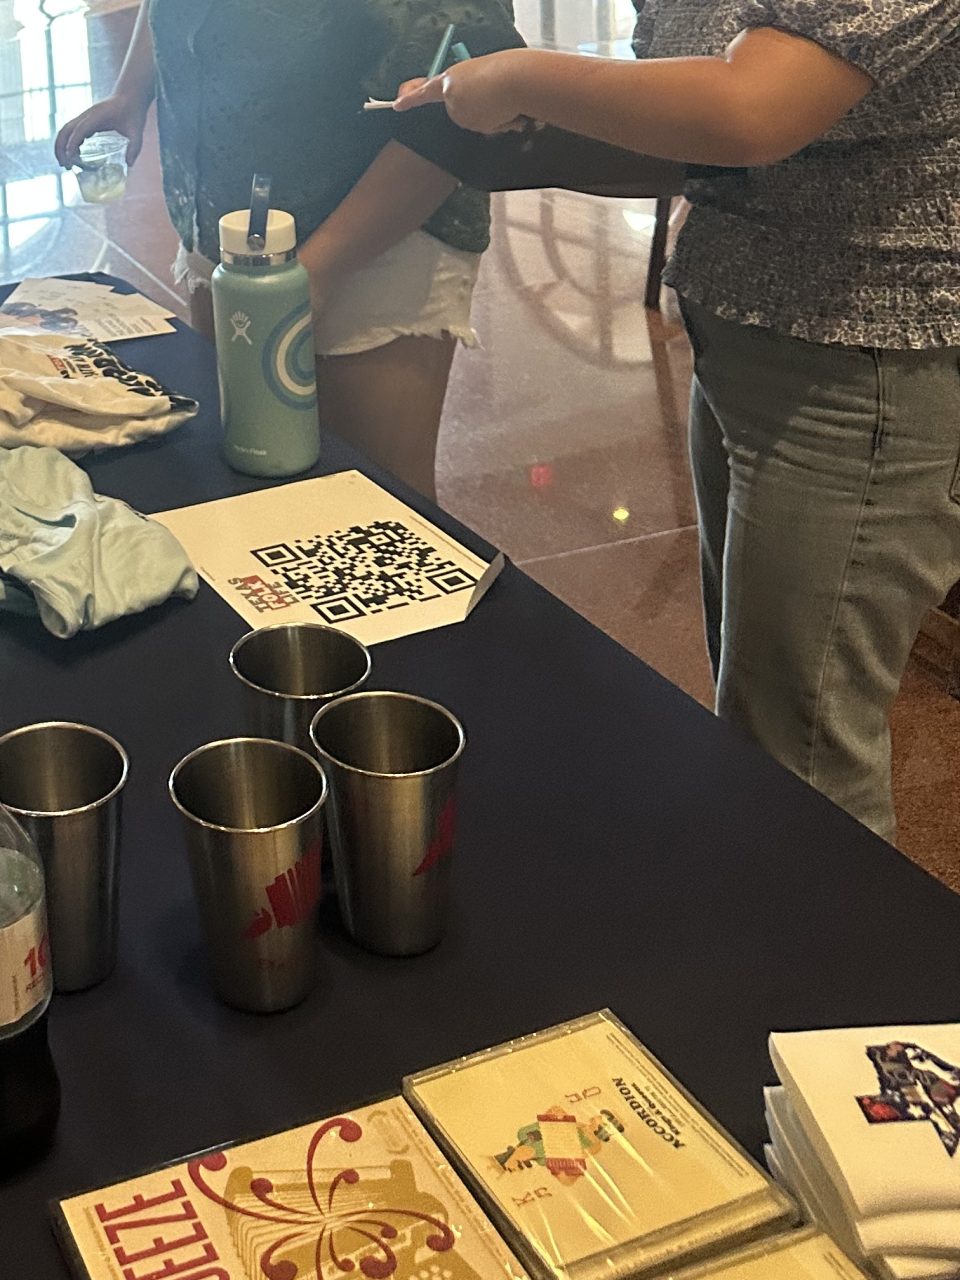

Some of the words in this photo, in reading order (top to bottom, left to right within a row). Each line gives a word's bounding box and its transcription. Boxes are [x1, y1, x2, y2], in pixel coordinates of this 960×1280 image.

[227, 577, 269, 612] TEXAS
[246, 579, 287, 609] FOLK
[611, 1077, 685, 1148] ACCORDION
